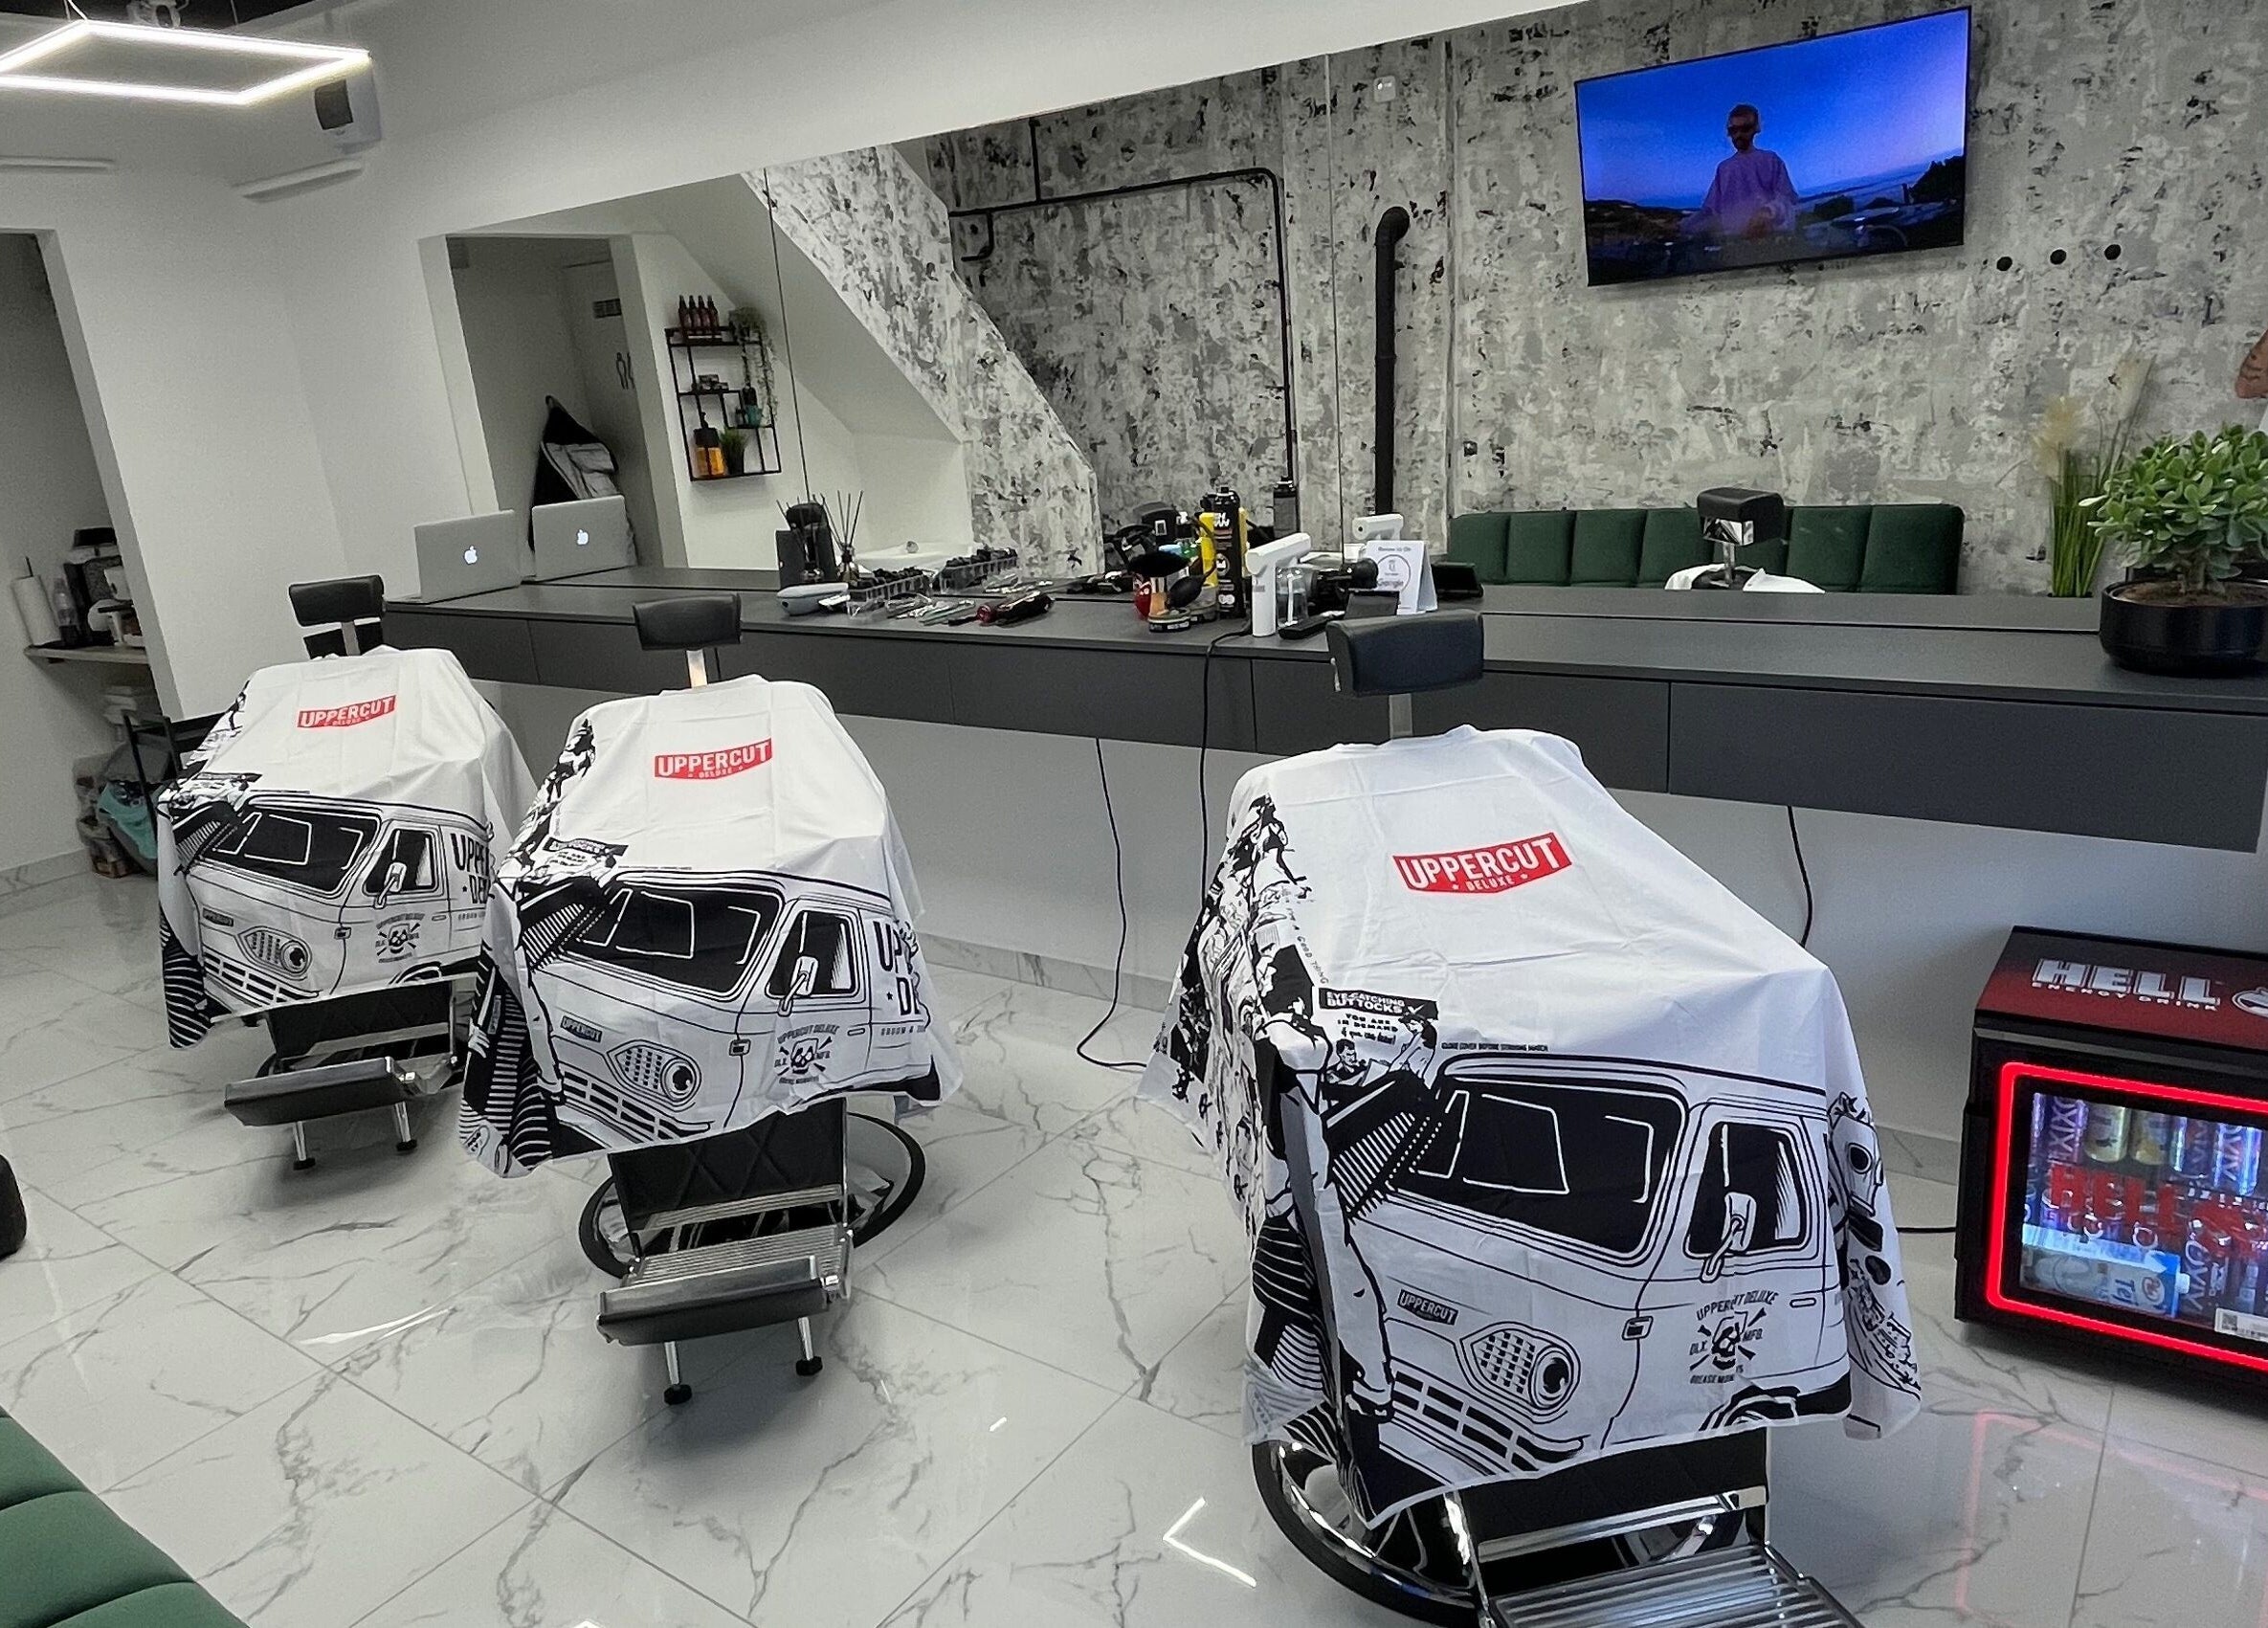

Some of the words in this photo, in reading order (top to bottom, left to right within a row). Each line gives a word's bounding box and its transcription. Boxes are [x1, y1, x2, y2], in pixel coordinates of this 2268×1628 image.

[300, 697, 394, 727] UPPERCUT
[657, 742, 770, 776] UPPERCUT
[1399, 837, 1561, 889] UPPERCUT
[1466, 875, 1515, 892] DELUXE
[2031, 981, 2128, 999] ENERGY
[2138, 994, 2218, 1012] DRINK
[2032, 958, 2221, 1006] HELL
[1326, 998, 1403, 1014] BUTTOCKS
[1399, 1291, 1456, 1324] UPPERCUT
[2111, 1279, 2139, 1306] Tej
